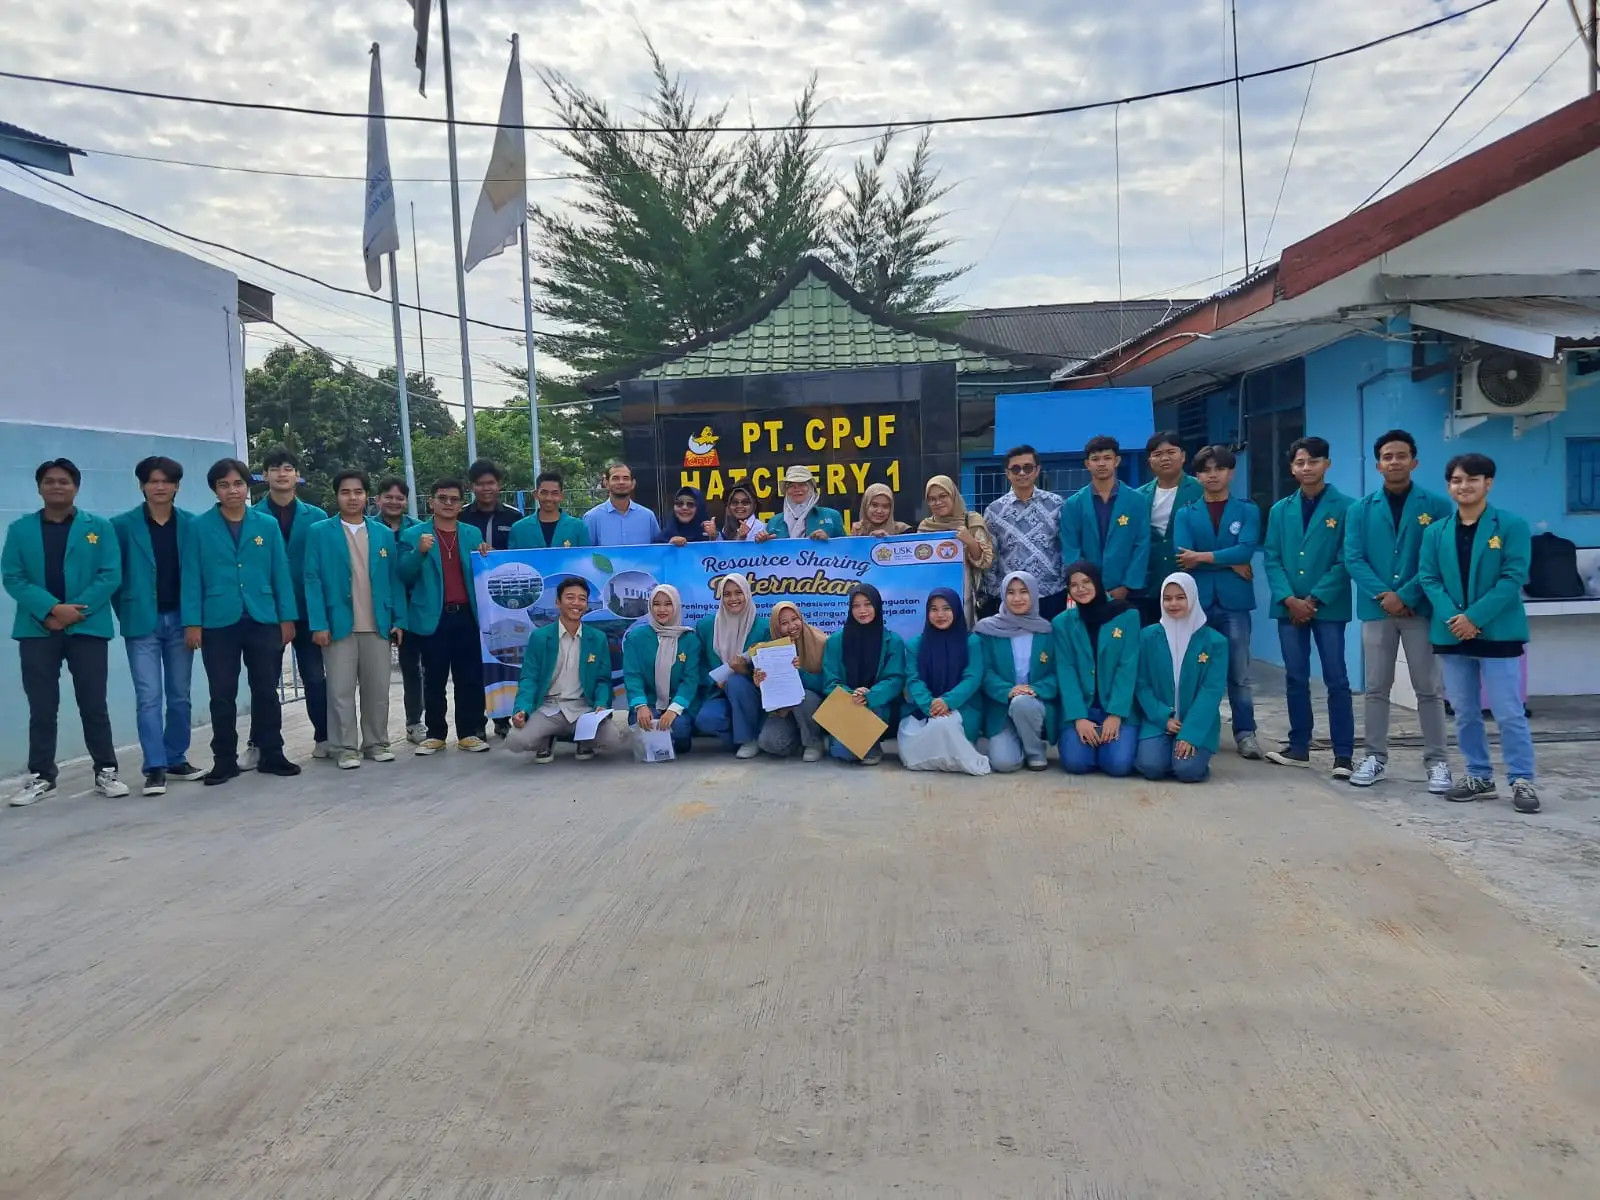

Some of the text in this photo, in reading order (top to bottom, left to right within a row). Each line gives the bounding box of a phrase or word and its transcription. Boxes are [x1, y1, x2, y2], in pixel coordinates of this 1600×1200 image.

[742, 414, 896, 453] PT. CPJF
[886, 460, 900, 492] 1
[893, 547, 913, 555] USK
[702, 550, 872, 577] Resource Sharing
[813, 610, 846, 619] dengan
[819, 619, 836, 627] dan
